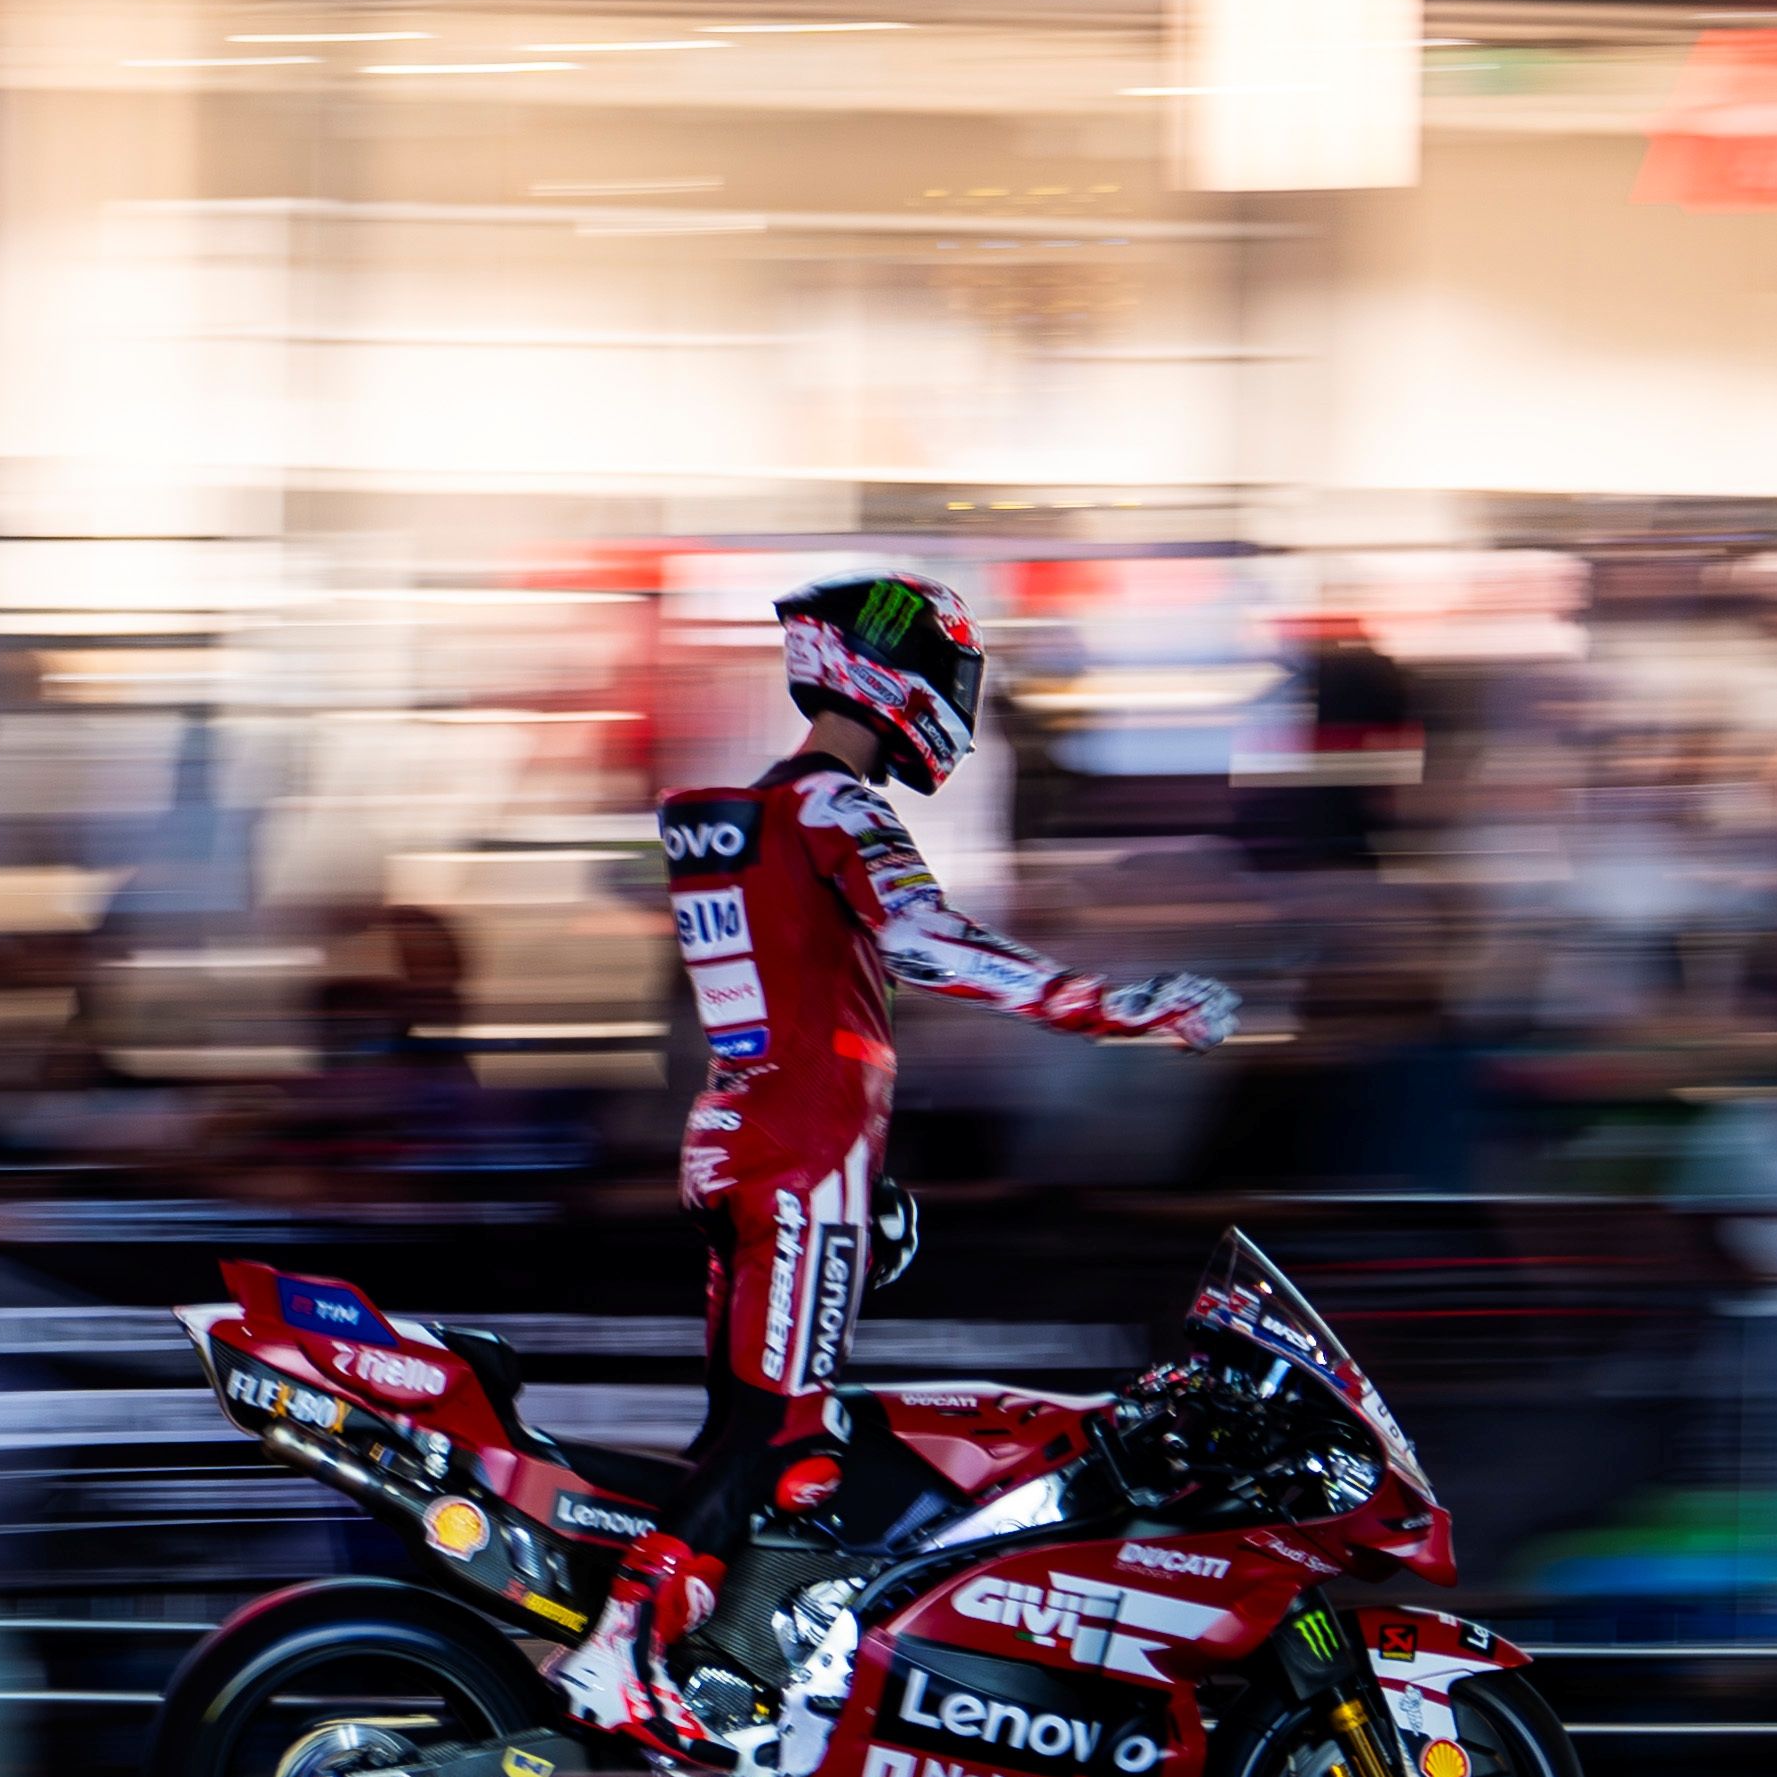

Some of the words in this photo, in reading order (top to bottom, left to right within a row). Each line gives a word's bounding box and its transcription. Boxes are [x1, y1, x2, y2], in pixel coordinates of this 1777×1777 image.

[811, 1235, 856, 1378] Lenovo
[901, 1393, 977, 1408] DUCATI
[1117, 1541, 1232, 1579] DUCATI
[951, 1575, 1081, 1639] GIVI
[899, 1667, 1158, 1773] Lenovo
